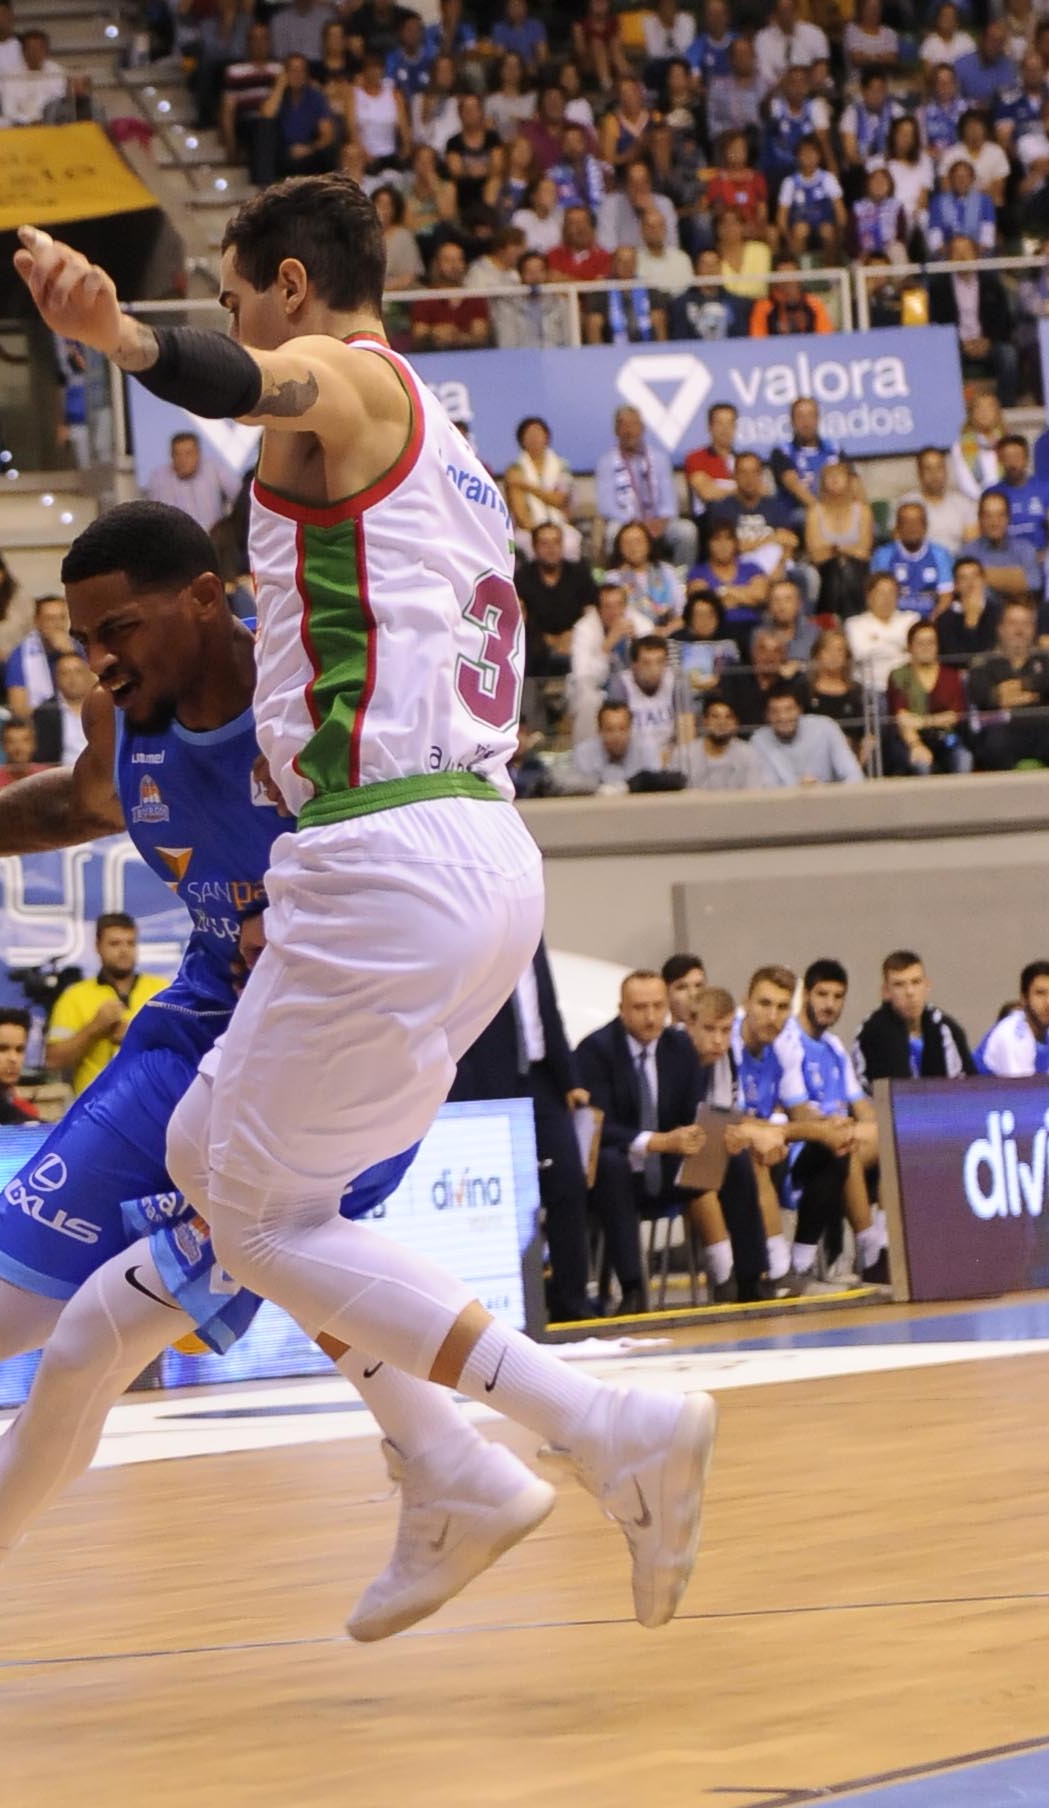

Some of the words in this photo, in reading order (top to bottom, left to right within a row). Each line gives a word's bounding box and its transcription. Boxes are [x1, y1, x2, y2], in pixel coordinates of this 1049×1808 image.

[728, 351, 911, 407] valora
[455, 568, 522, 734] 3
[432, 1166, 502, 1210] divina
